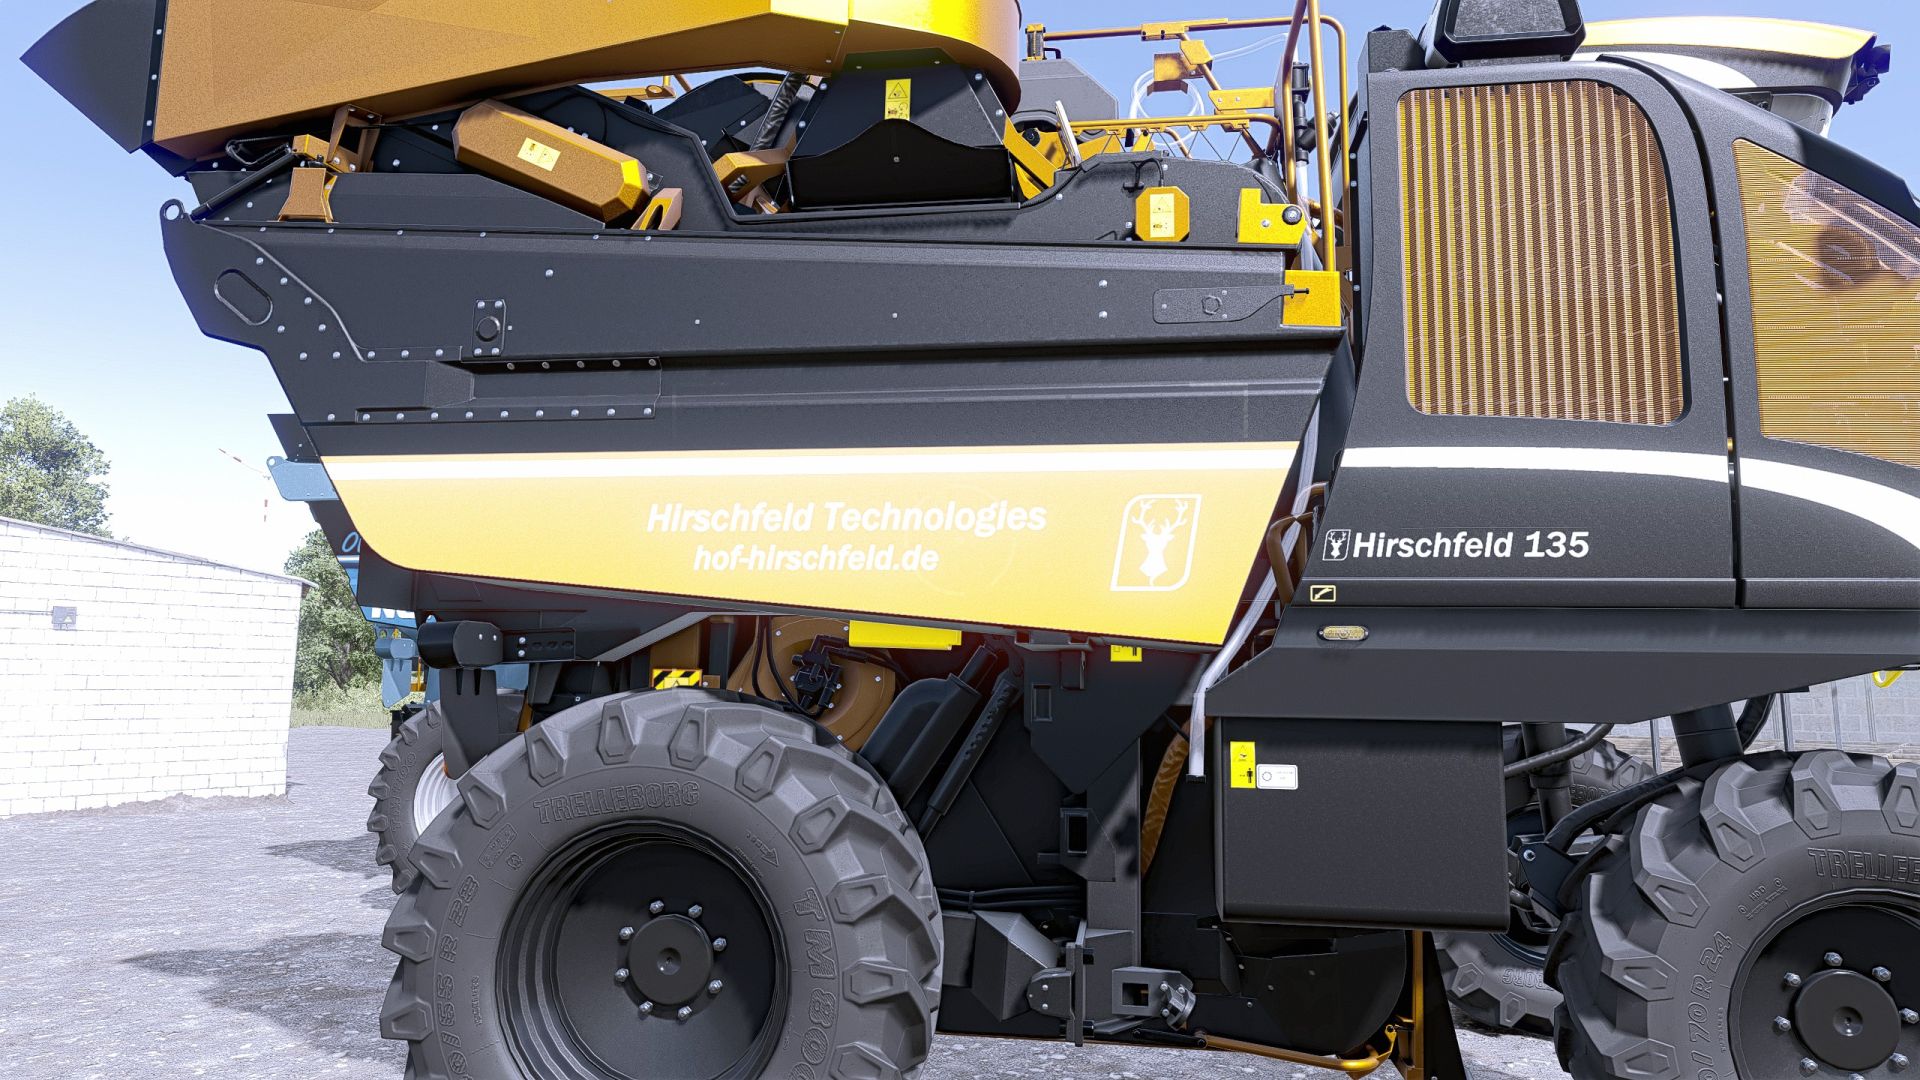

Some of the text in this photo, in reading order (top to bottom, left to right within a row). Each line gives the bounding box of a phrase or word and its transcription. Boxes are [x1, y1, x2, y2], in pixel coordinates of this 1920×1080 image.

[646, 500, 1048, 538] Hirschfeld Technologies
[693, 543, 940, 572] hof-hirschfeld.de
[1352, 530, 1589, 558] Hirschfeld 135
[534, 780, 700, 824] TRELLEBORG
[1700, 930, 1732, 973] 24
[1690, 974, 1713, 1000] R
